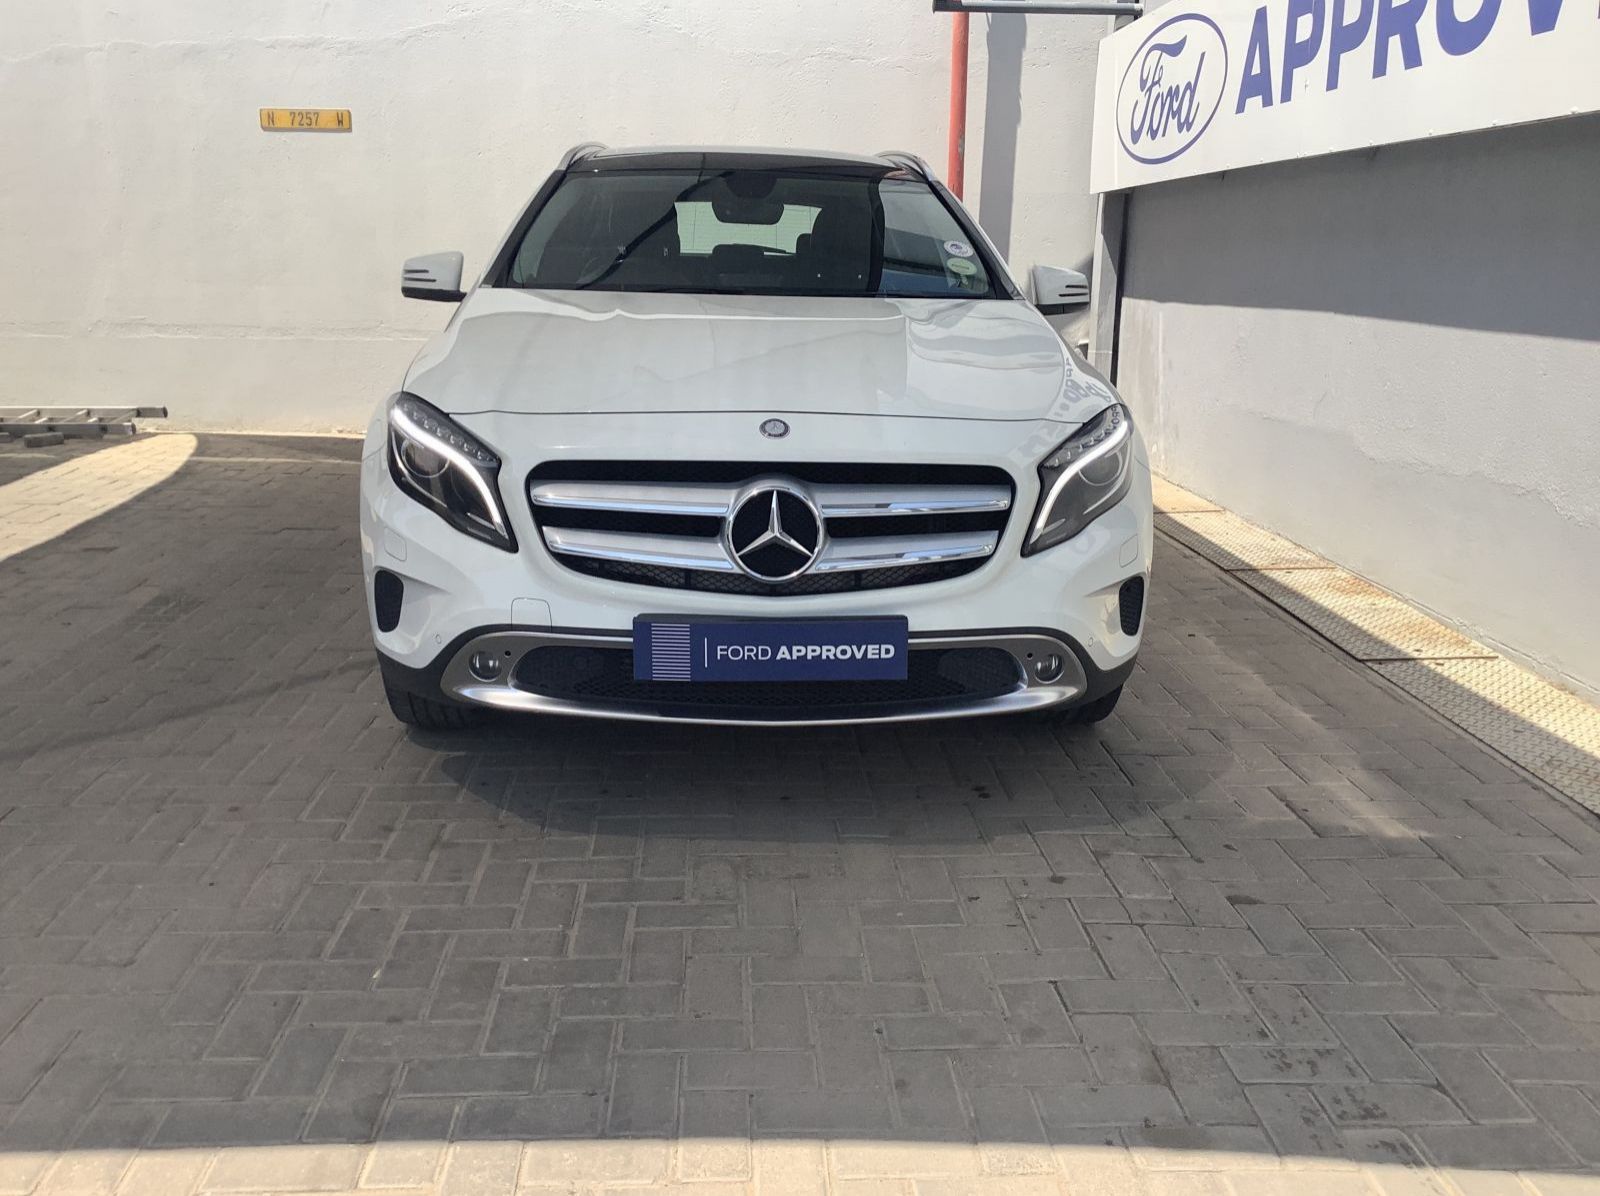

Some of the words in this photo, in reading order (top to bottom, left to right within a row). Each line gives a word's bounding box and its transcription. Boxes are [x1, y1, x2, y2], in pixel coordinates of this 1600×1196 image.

[1130, 34, 1206, 145] Ford
[1234, 0, 1564, 115] APPRO
[267, 111, 275, 127] N
[289, 111, 320, 127] 7257
[716, 645, 771, 661] FORD
[776, 644, 895, 660] APPROVED
